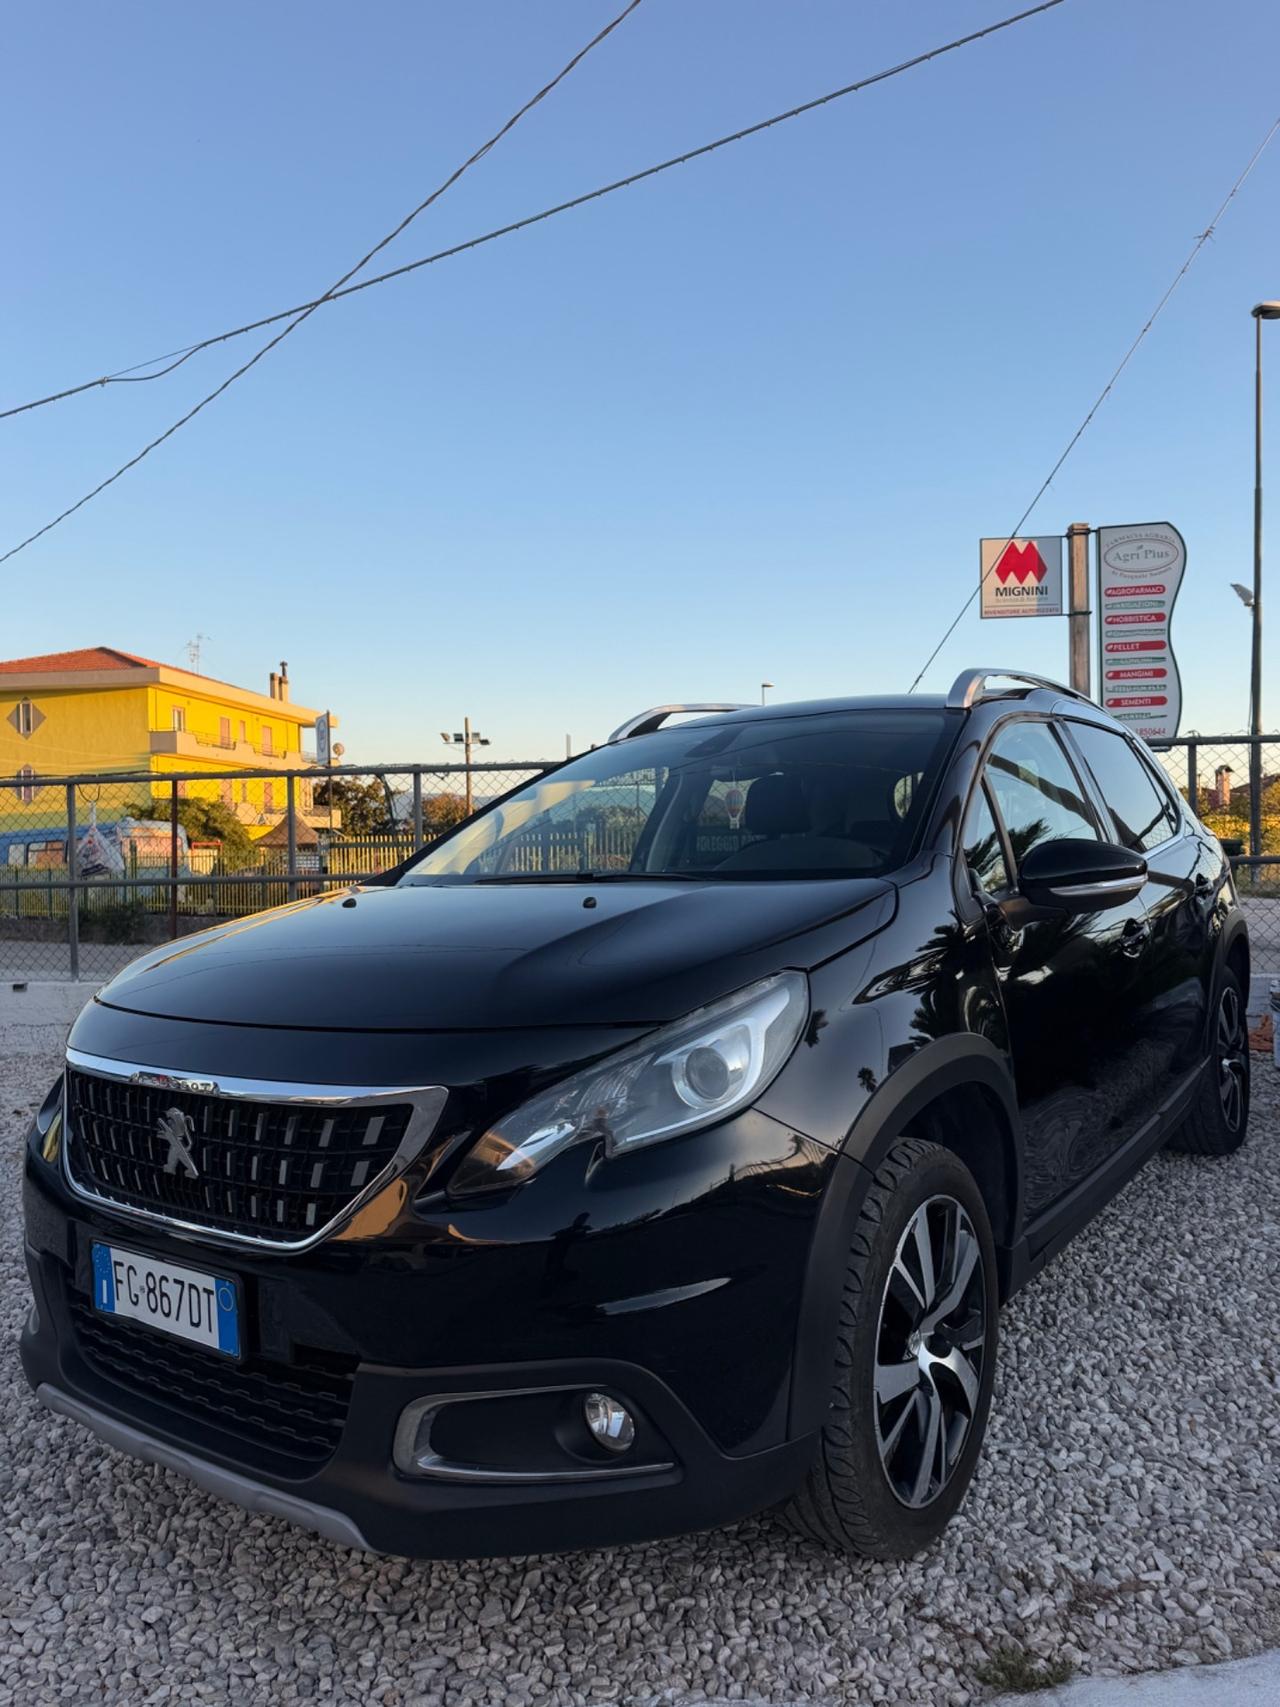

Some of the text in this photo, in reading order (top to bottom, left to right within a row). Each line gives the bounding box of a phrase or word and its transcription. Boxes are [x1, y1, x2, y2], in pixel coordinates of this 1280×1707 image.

[1113, 549, 1170, 563] Agri Plus
[995, 586, 1048, 597] MIGNINI
[1111, 586, 1163, 595] AGROFARMACI
[1113, 614, 1156, 623] HOBBISTICA
[1113, 643, 1140, 651] PELLET
[1119, 669, 1154, 678] MANGIMI
[1120, 697, 1152, 706] SEMENTI
[113, 1260, 139, 1306] FG
[145, 1271, 214, 1333] 867DT
